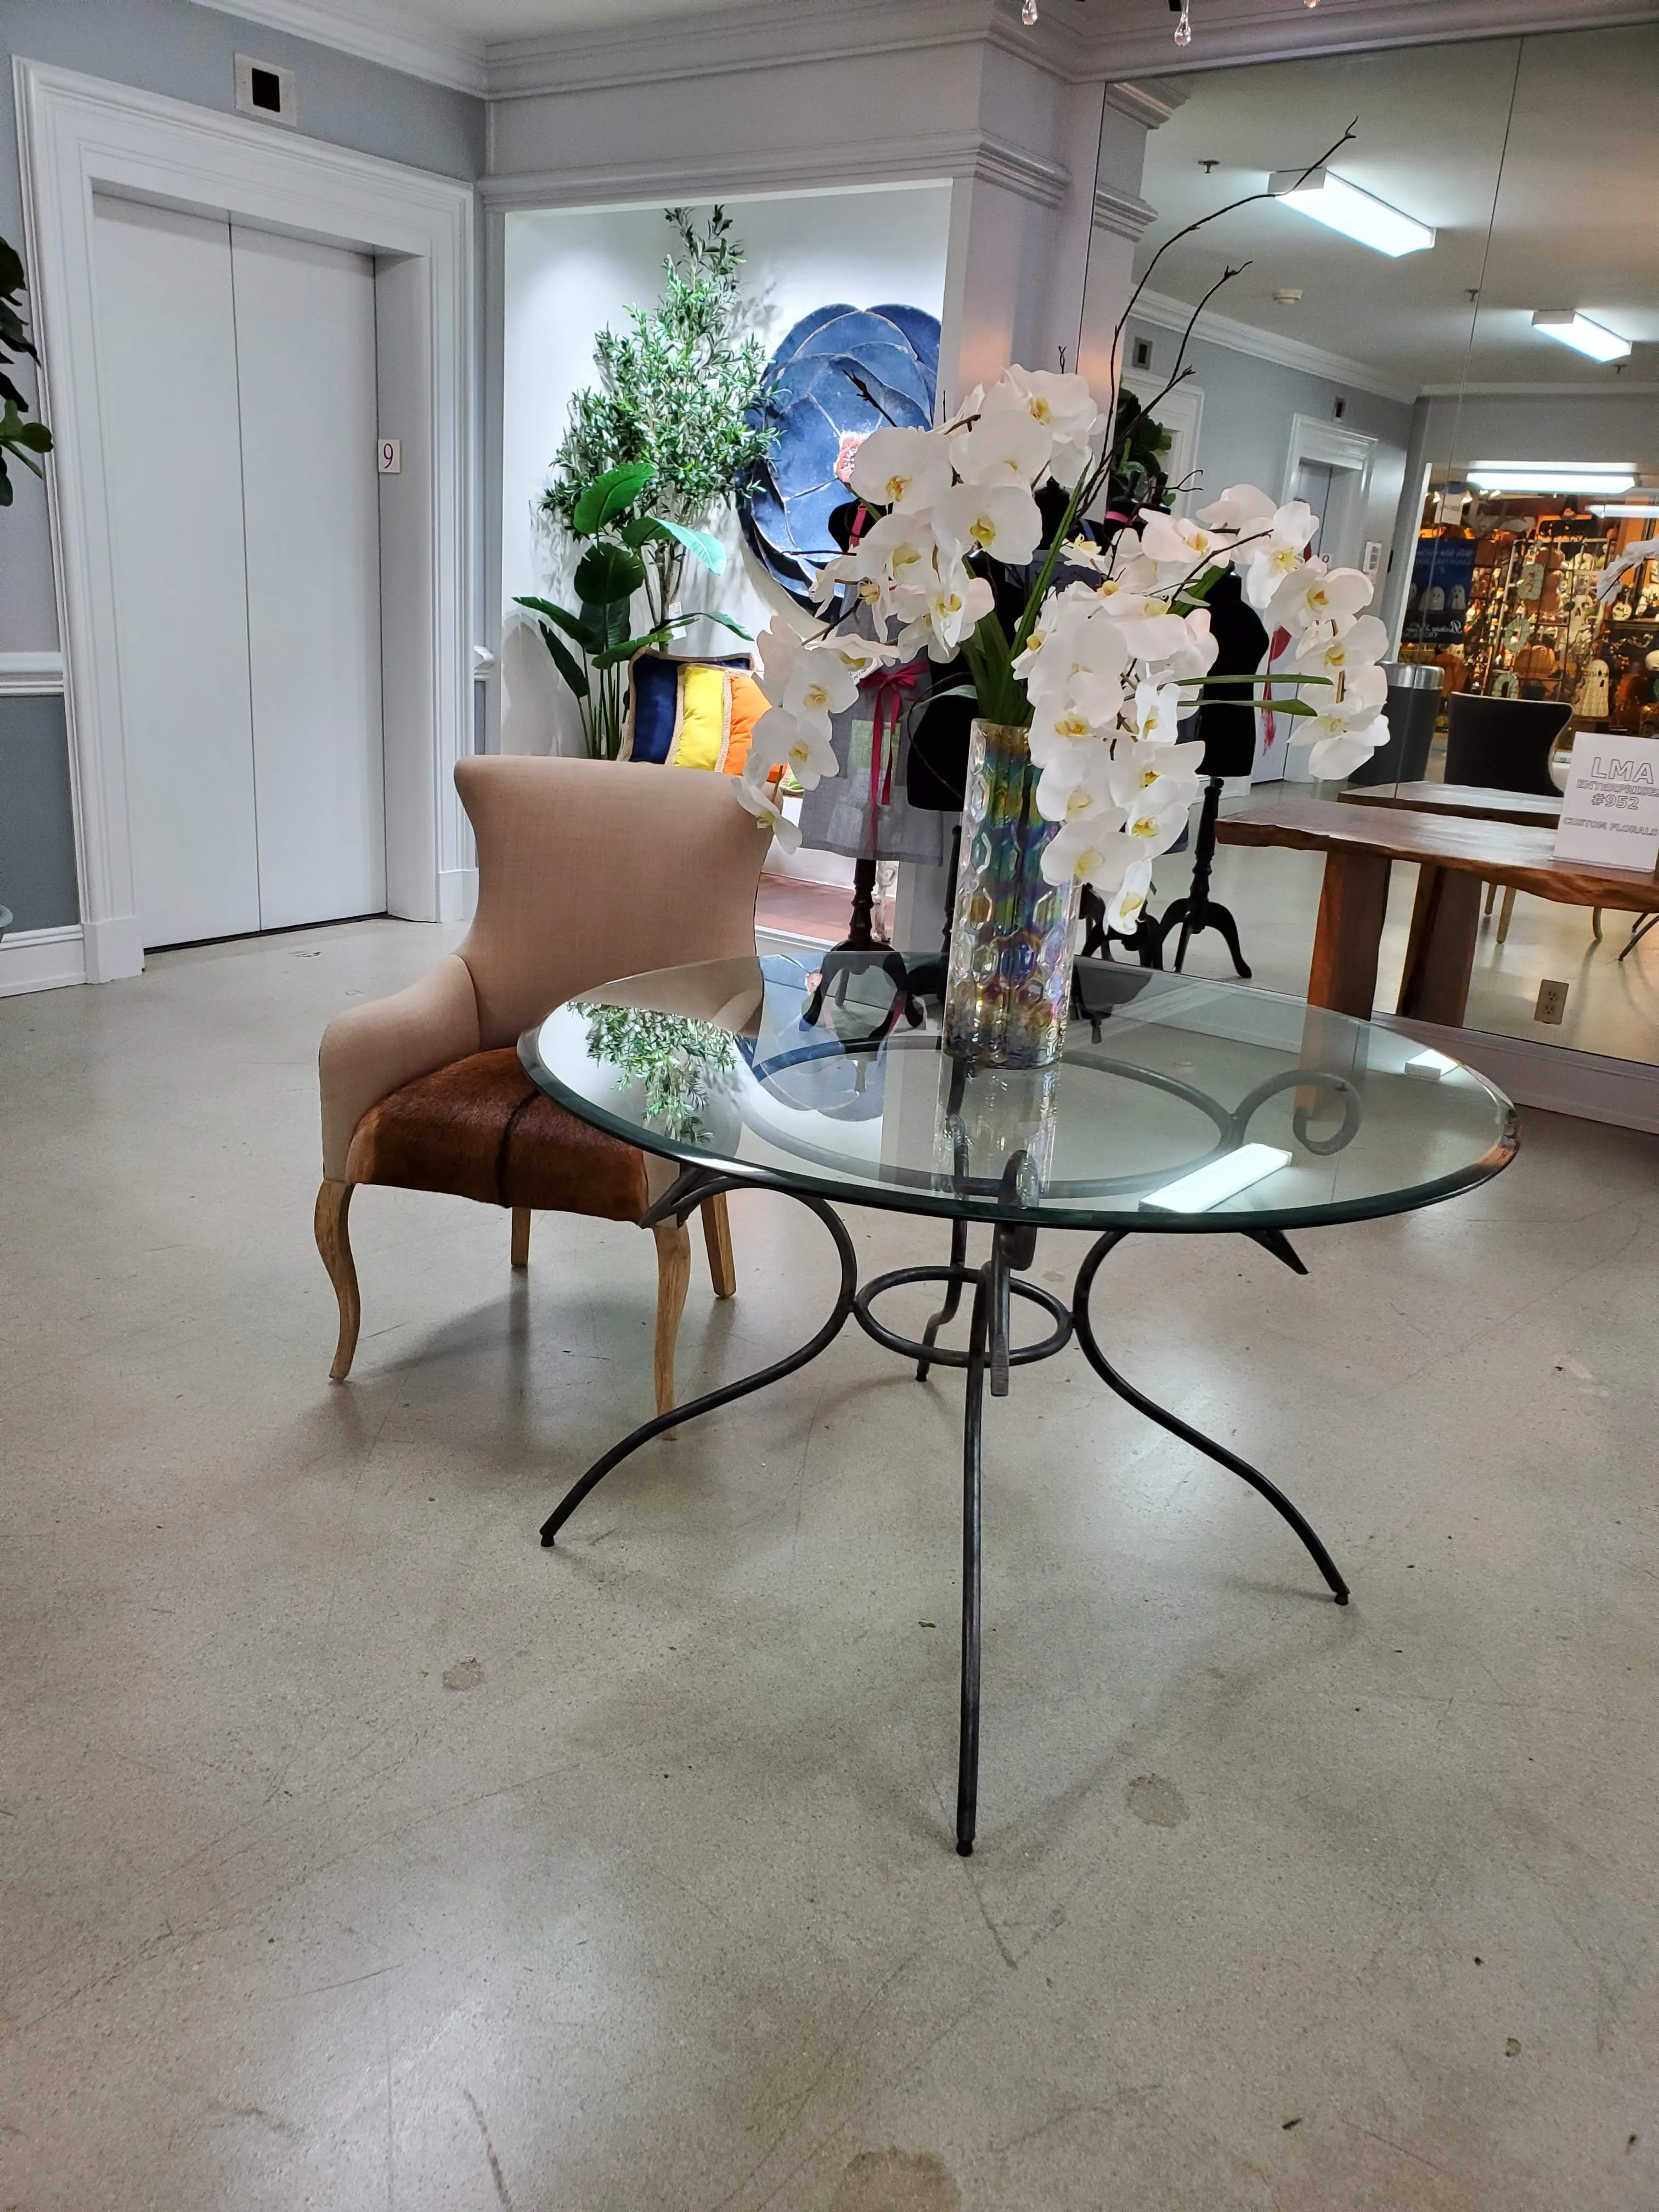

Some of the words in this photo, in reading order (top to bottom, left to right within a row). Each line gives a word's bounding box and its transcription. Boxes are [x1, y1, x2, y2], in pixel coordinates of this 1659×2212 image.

[383, 443, 393, 469] 9
[1591, 757, 1654, 785] LMA
[1591, 793, 1639, 810] #952
[1563, 817, 1607, 830] CUSTOM
[1609, 822, 1658, 837] FLORALS
